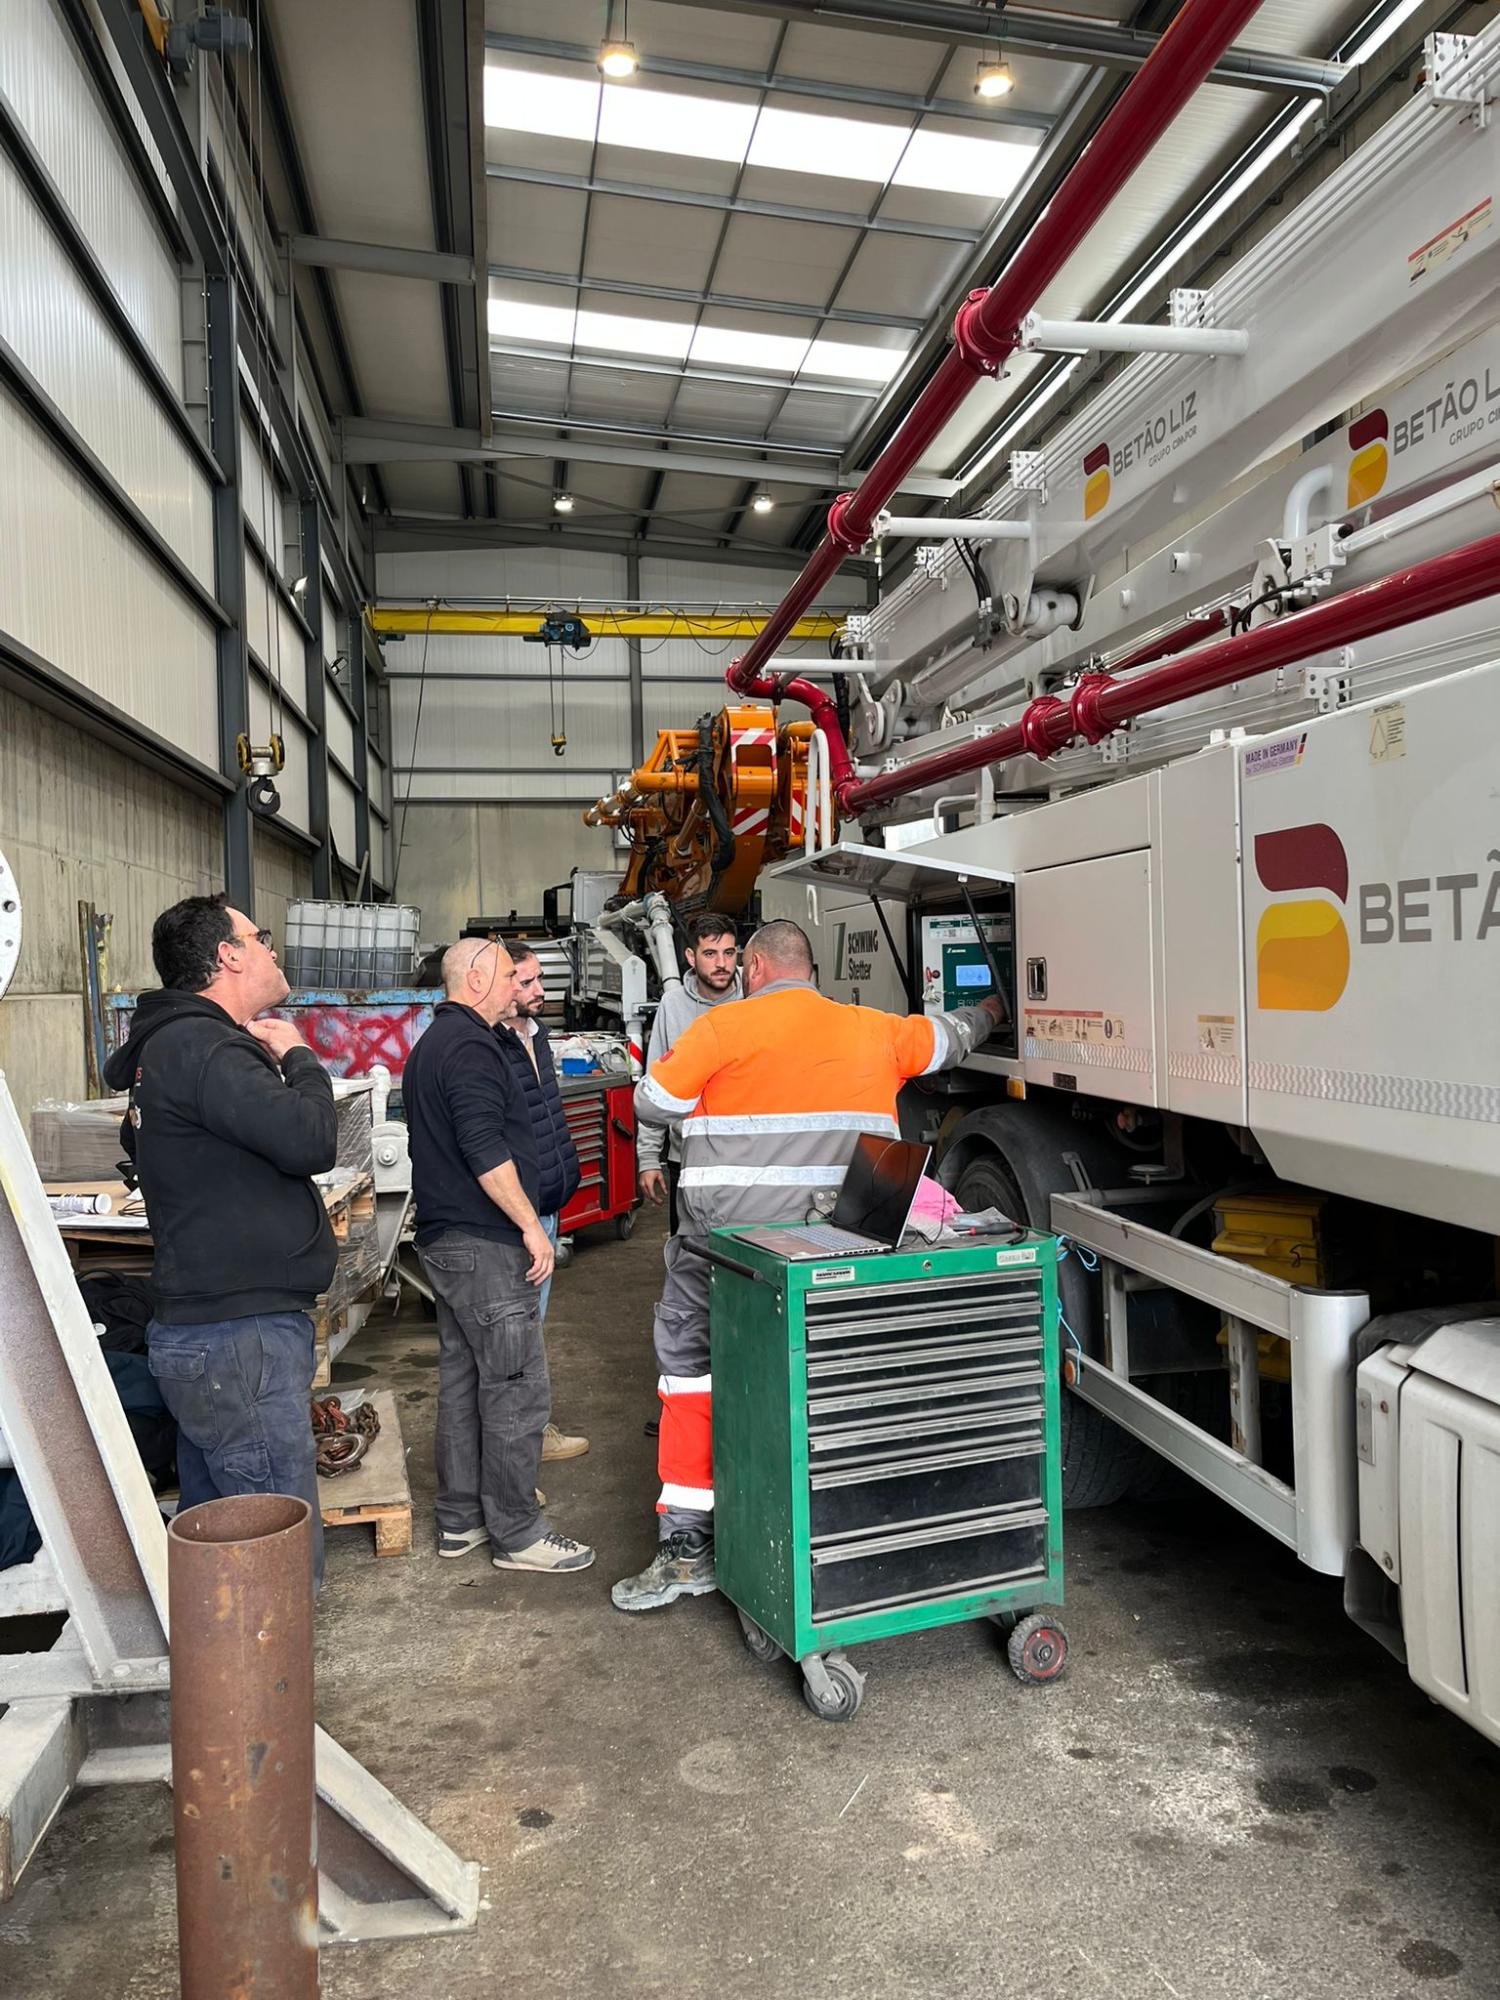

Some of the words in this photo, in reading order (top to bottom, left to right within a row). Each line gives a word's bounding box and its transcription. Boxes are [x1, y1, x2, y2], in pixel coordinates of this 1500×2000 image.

[1394, 379, 1478, 456] BETÃO
[1113, 416, 1166, 477] BETÃO
[1169, 390, 1197, 434] LIZ
[1449, 417, 1485, 446] GRUPO
[1148, 444, 1171, 468] GRUPO
[1245, 749, 1262, 764] MADE
[1270, 738, 1298, 757] GERMANY
[848, 929, 878, 954] SCHWING
[848, 957, 872, 980] Stetter
